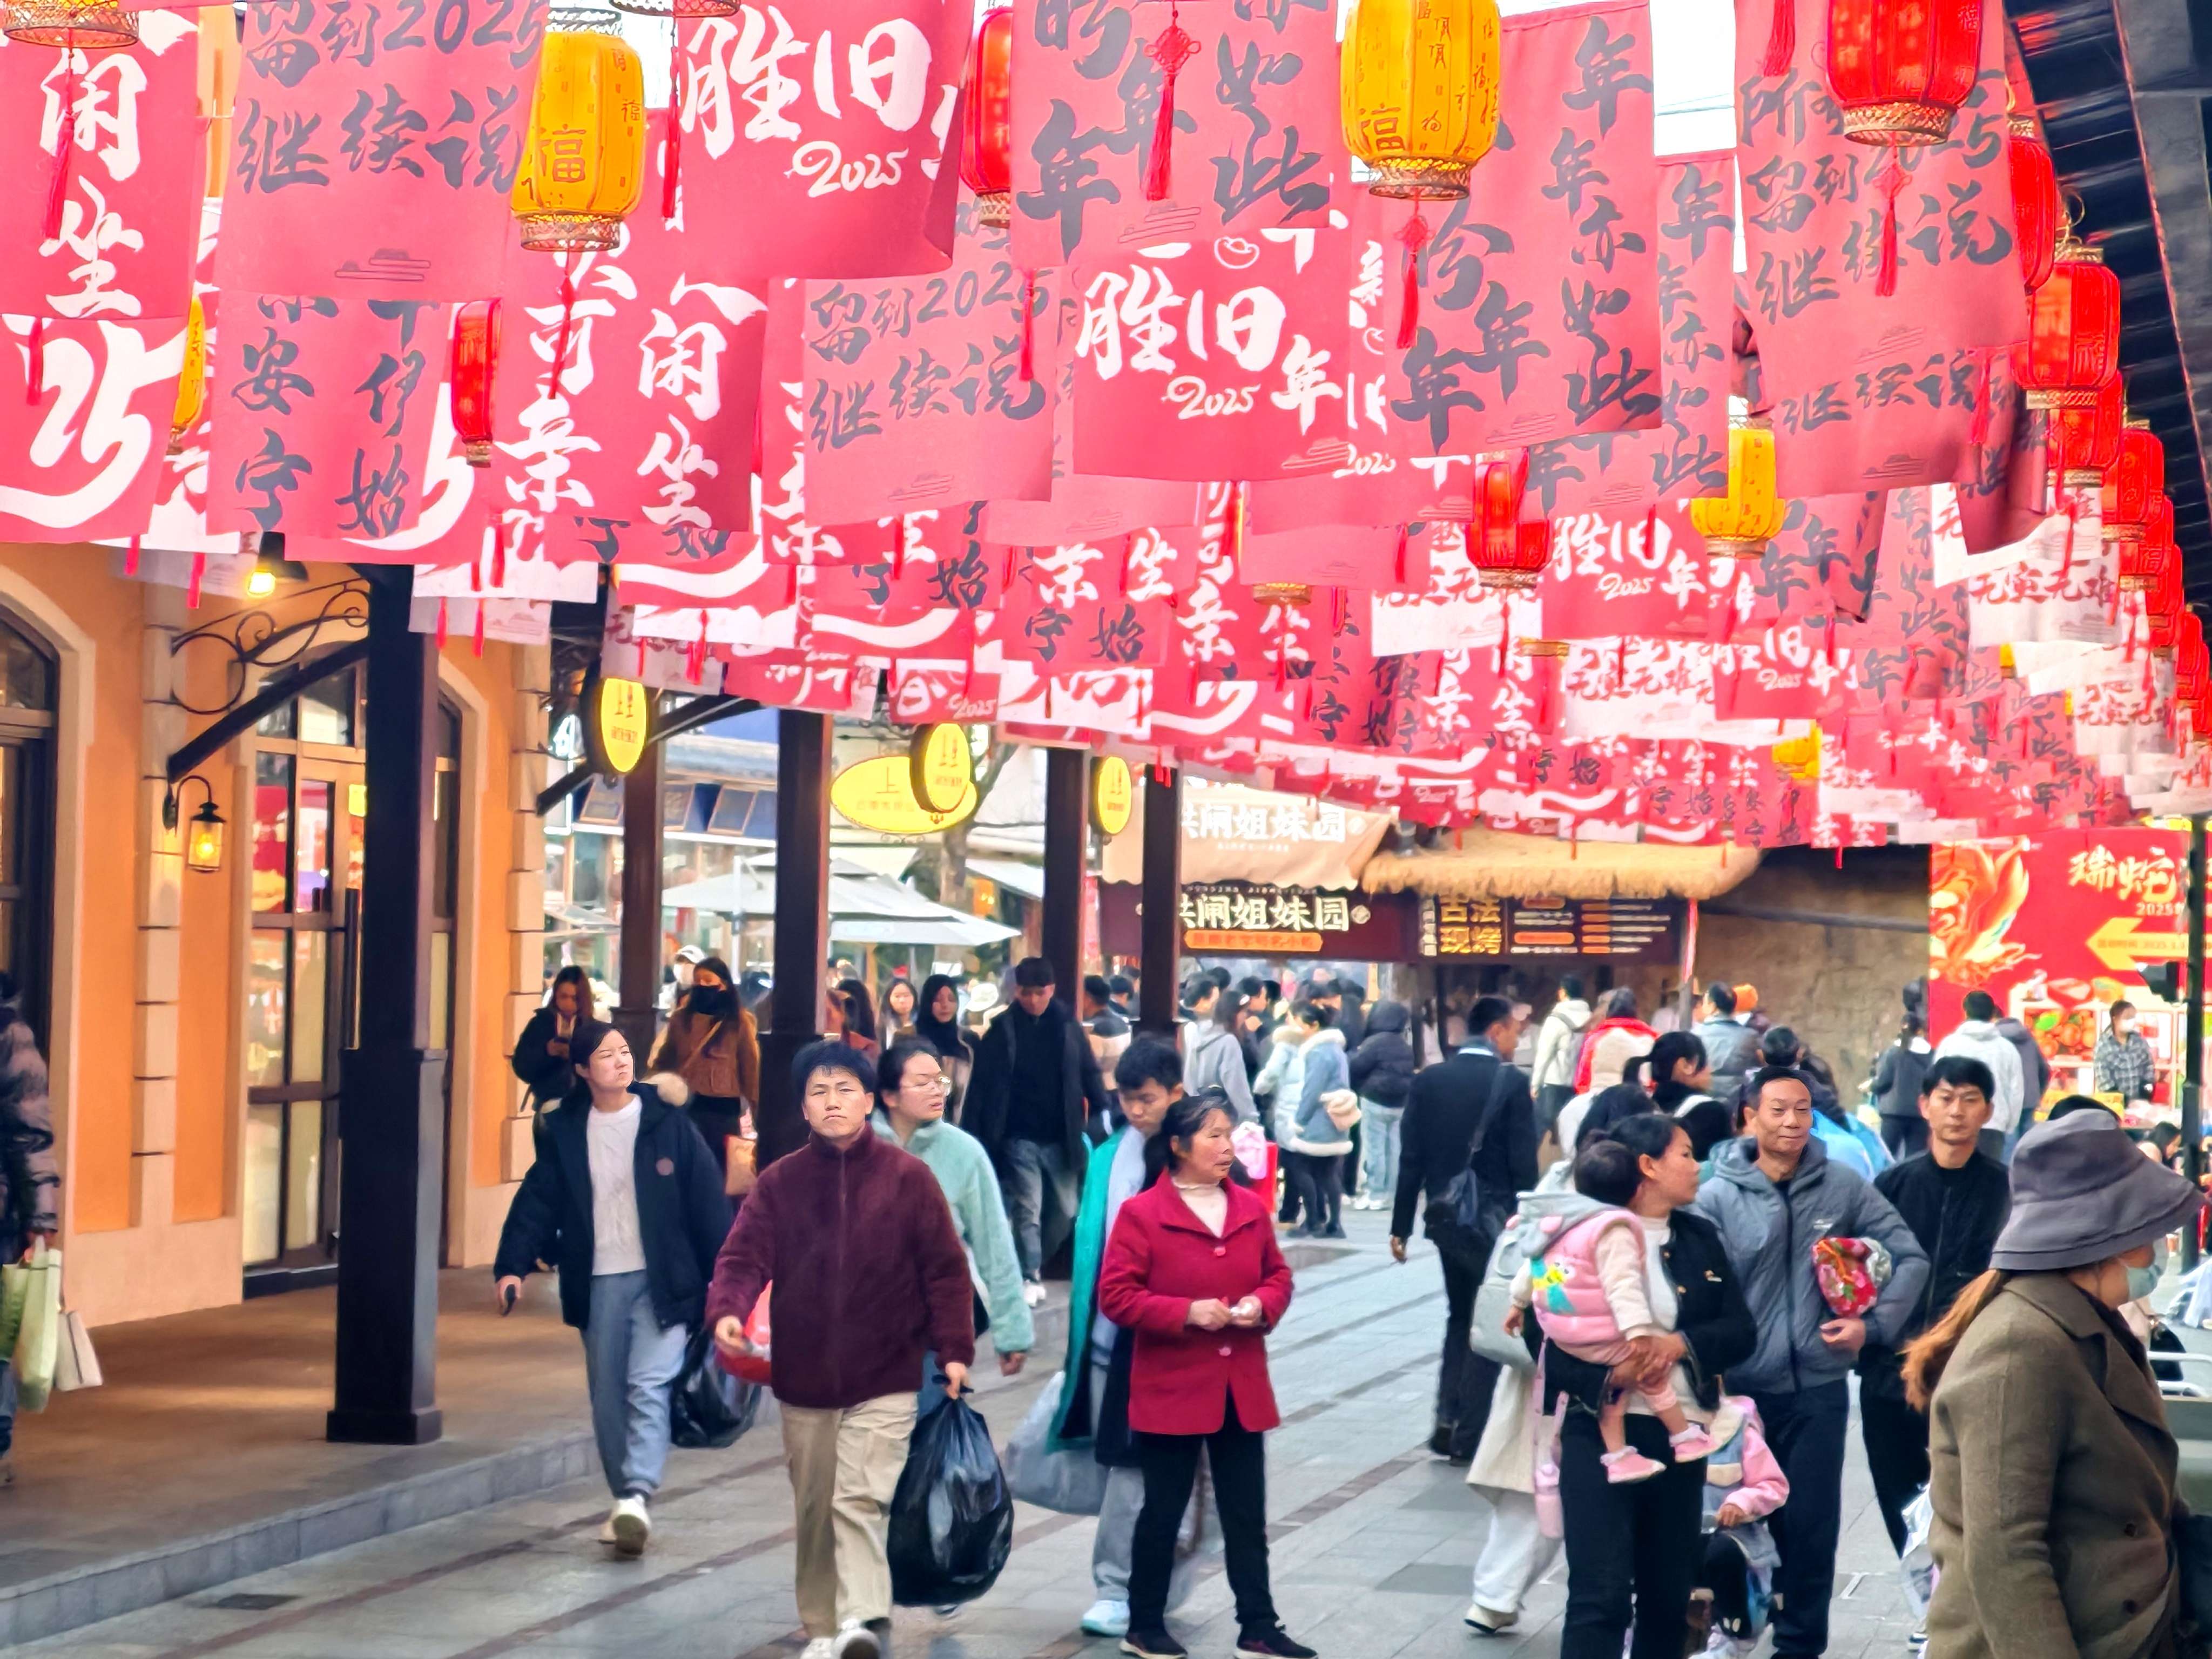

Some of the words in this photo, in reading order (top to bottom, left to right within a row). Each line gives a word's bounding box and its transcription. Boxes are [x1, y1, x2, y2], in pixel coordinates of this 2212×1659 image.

[785, 140, 909, 198] 2025
[232, 296, 339, 533] 安宁
[1161, 375, 1262, 420] 2025
